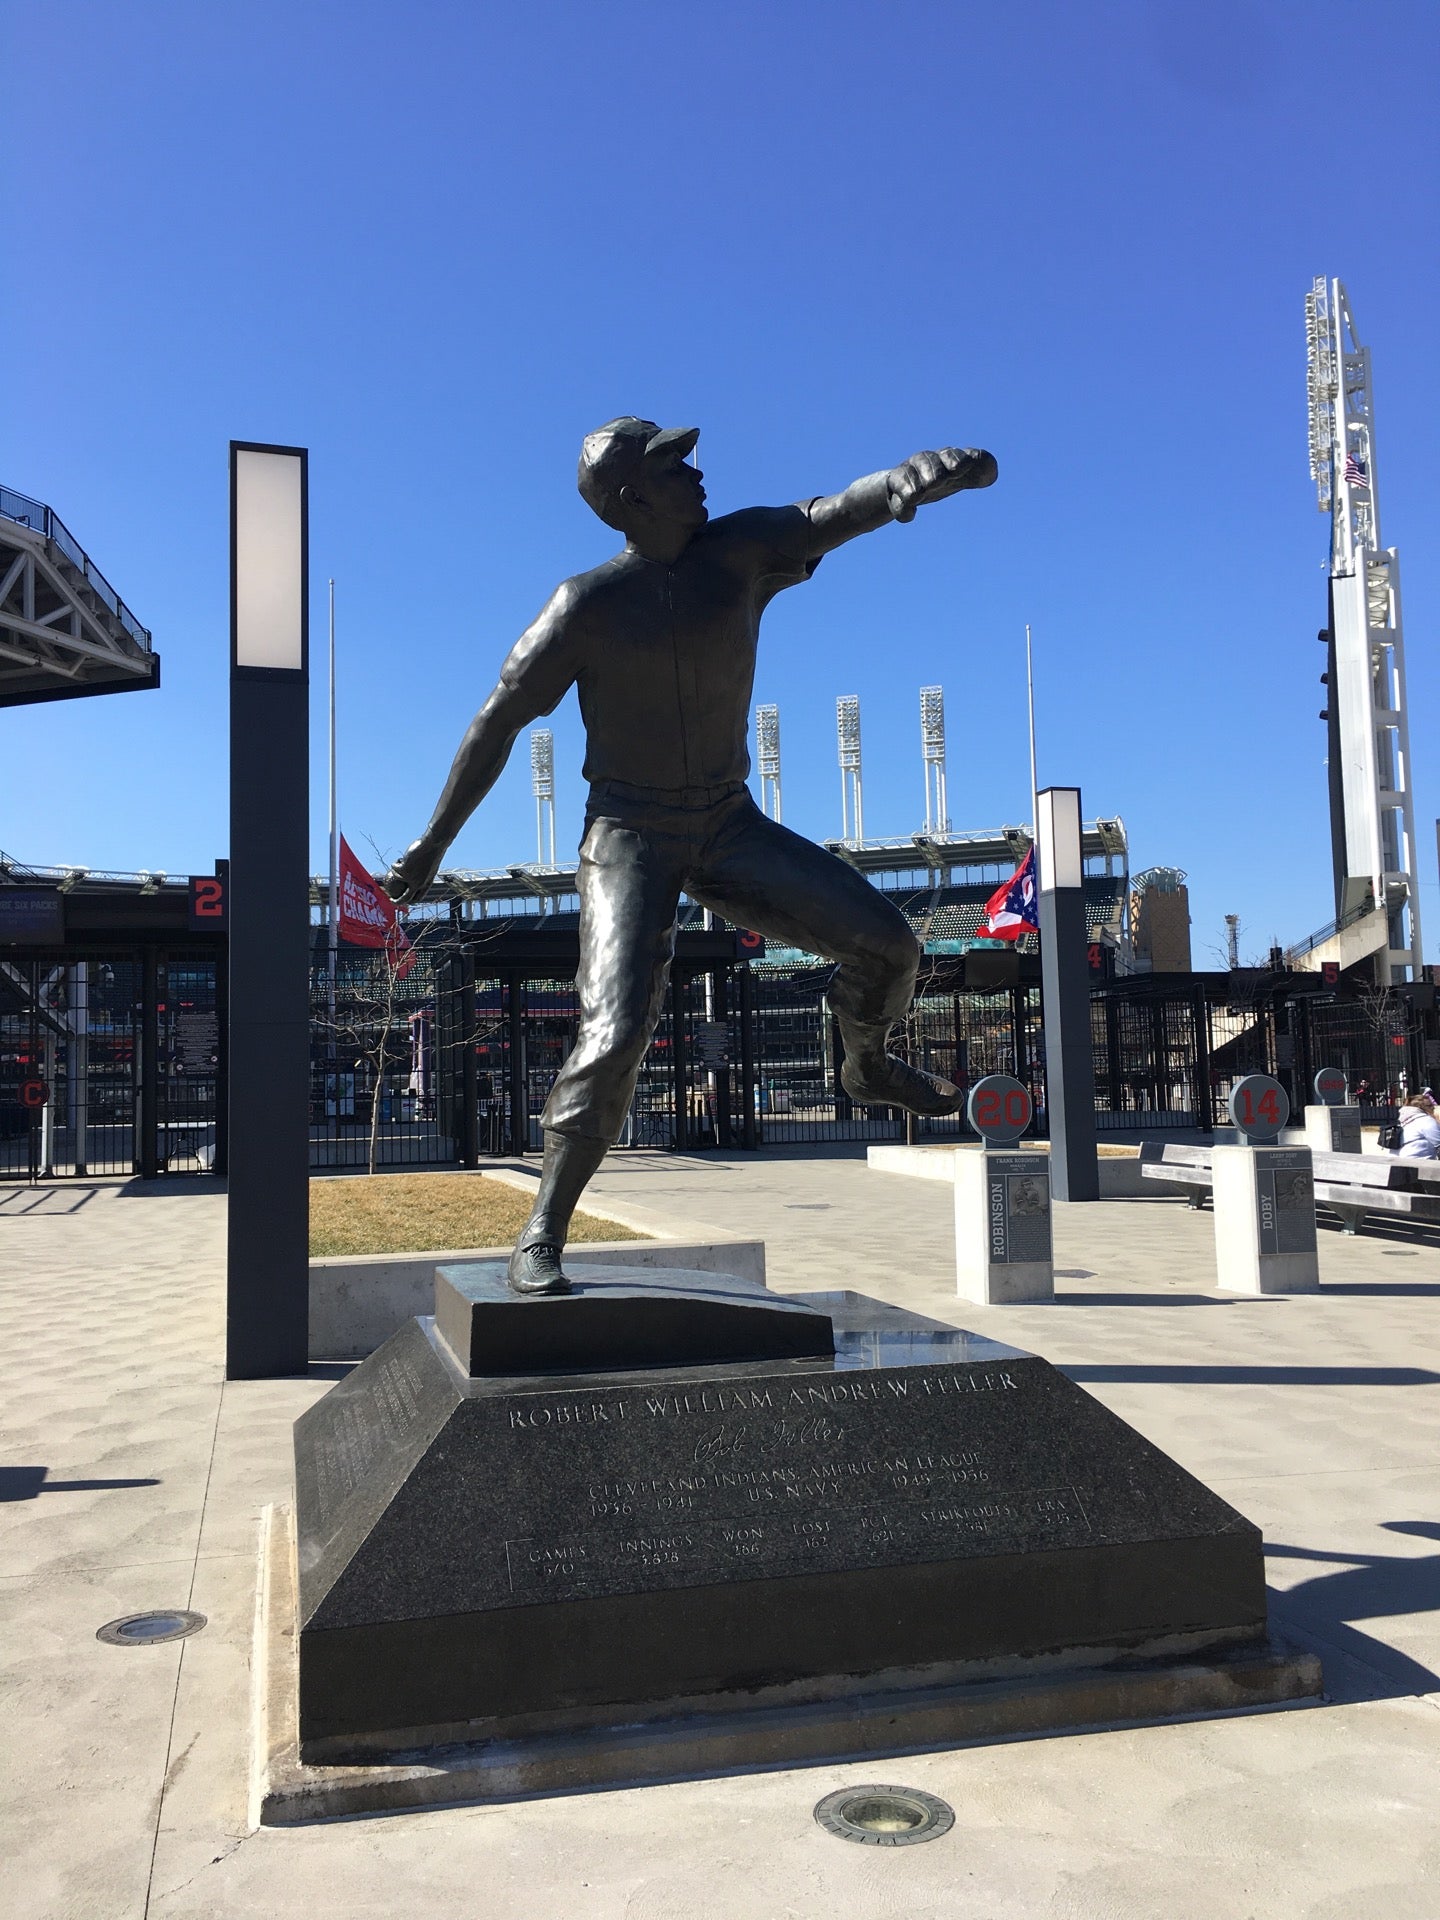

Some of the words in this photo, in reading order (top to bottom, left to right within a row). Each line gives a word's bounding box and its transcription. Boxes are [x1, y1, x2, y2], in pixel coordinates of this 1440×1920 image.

[195, 880, 222, 916] 2
[1087, 943, 1101, 968] 4
[1325, 962, 1338, 984] 5
[24, 1082, 42, 1105] C
[977, 1089, 1028, 1126] 20
[1242, 1089, 1281, 1125] 14
[991, 1183, 1005, 1256] ROBINSON
[1261, 1194, 1273, 1230] DOBY
[509, 1400, 630, 1429] ROBERT
[646, 1390, 774, 1416] WILLIAM
[788, 1379, 909, 1406] ANDREW
[922, 1373, 1018, 1395] FELLER
[694, 1424, 751, 1463] Bob
[589, 1476, 706, 1499] CLEVELAND
[808, 1458, 909, 1479] AMERICAN
[916, 1452, 983, 1469] LEAGUE
[749, 1486, 778, 1502] U.S.
[786, 1479, 843, 1498] NAVY
[655, 1495, 693, 1510] 1941
[920, 1504, 1010, 1522] STRIKEOUTS
[722, 1527, 764, 1542] WON
[793, 1520, 831, 1534] LOST
[529, 1545, 586, 1562] GAMES
[619, 1535, 692, 1552] INNINGS
[805, 1535, 829, 1549] 162
